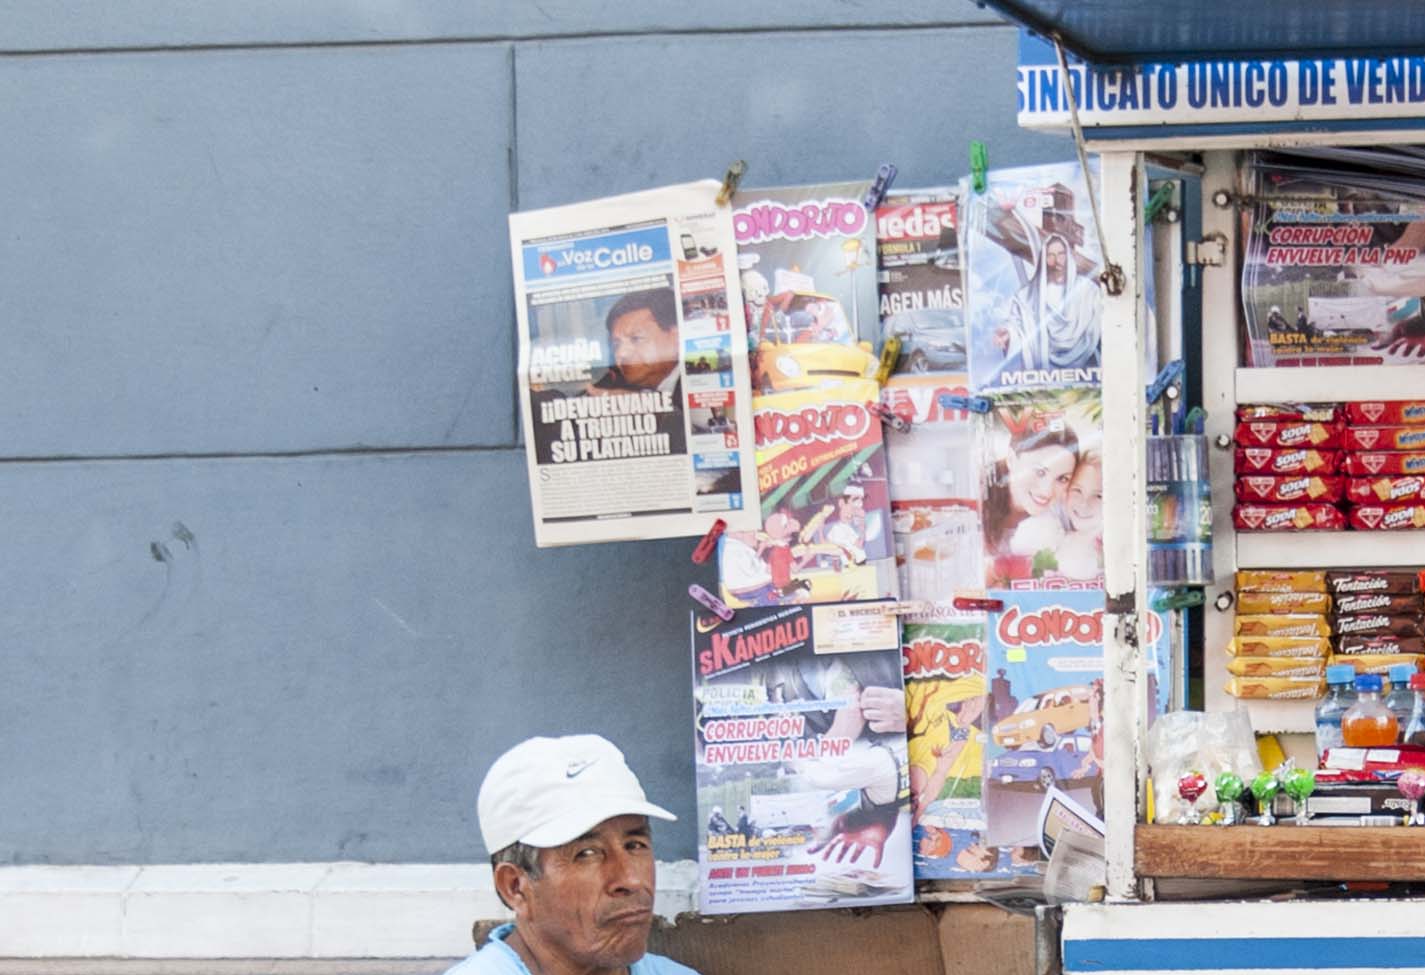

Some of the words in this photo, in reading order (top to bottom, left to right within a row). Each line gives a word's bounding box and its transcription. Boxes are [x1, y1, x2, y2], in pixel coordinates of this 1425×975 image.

[1016, 62, 1179, 113] SINDICATO
[1301, 58, 1340, 106] DE
[1270, 223, 1372, 245] CORRUPCIÓN
[562, 249, 593, 264] Voz
[594, 243, 653, 268] Calle
[1266, 248, 1342, 265] ENVUELVE
[1345, 249, 1358, 263] A
[1360, 249, 1379, 264] LA
[1384, 249, 1416, 264] PNP
[561, 420, 574, 441] A
[577, 414, 657, 439] TRUJILLO
[551, 439, 578, 463] SU
[1332, 576, 1388, 592] Tentación
[1337, 596, 1392, 614] Tentación
[1337, 616, 1391, 634] Tentación
[705, 716, 804, 741] CORRUPCIÓN
[706, 743, 779, 763] ENVUELVE
[783, 741, 795, 759] A
[798, 740, 816, 758] LA
[820, 738, 850, 757] PNP
